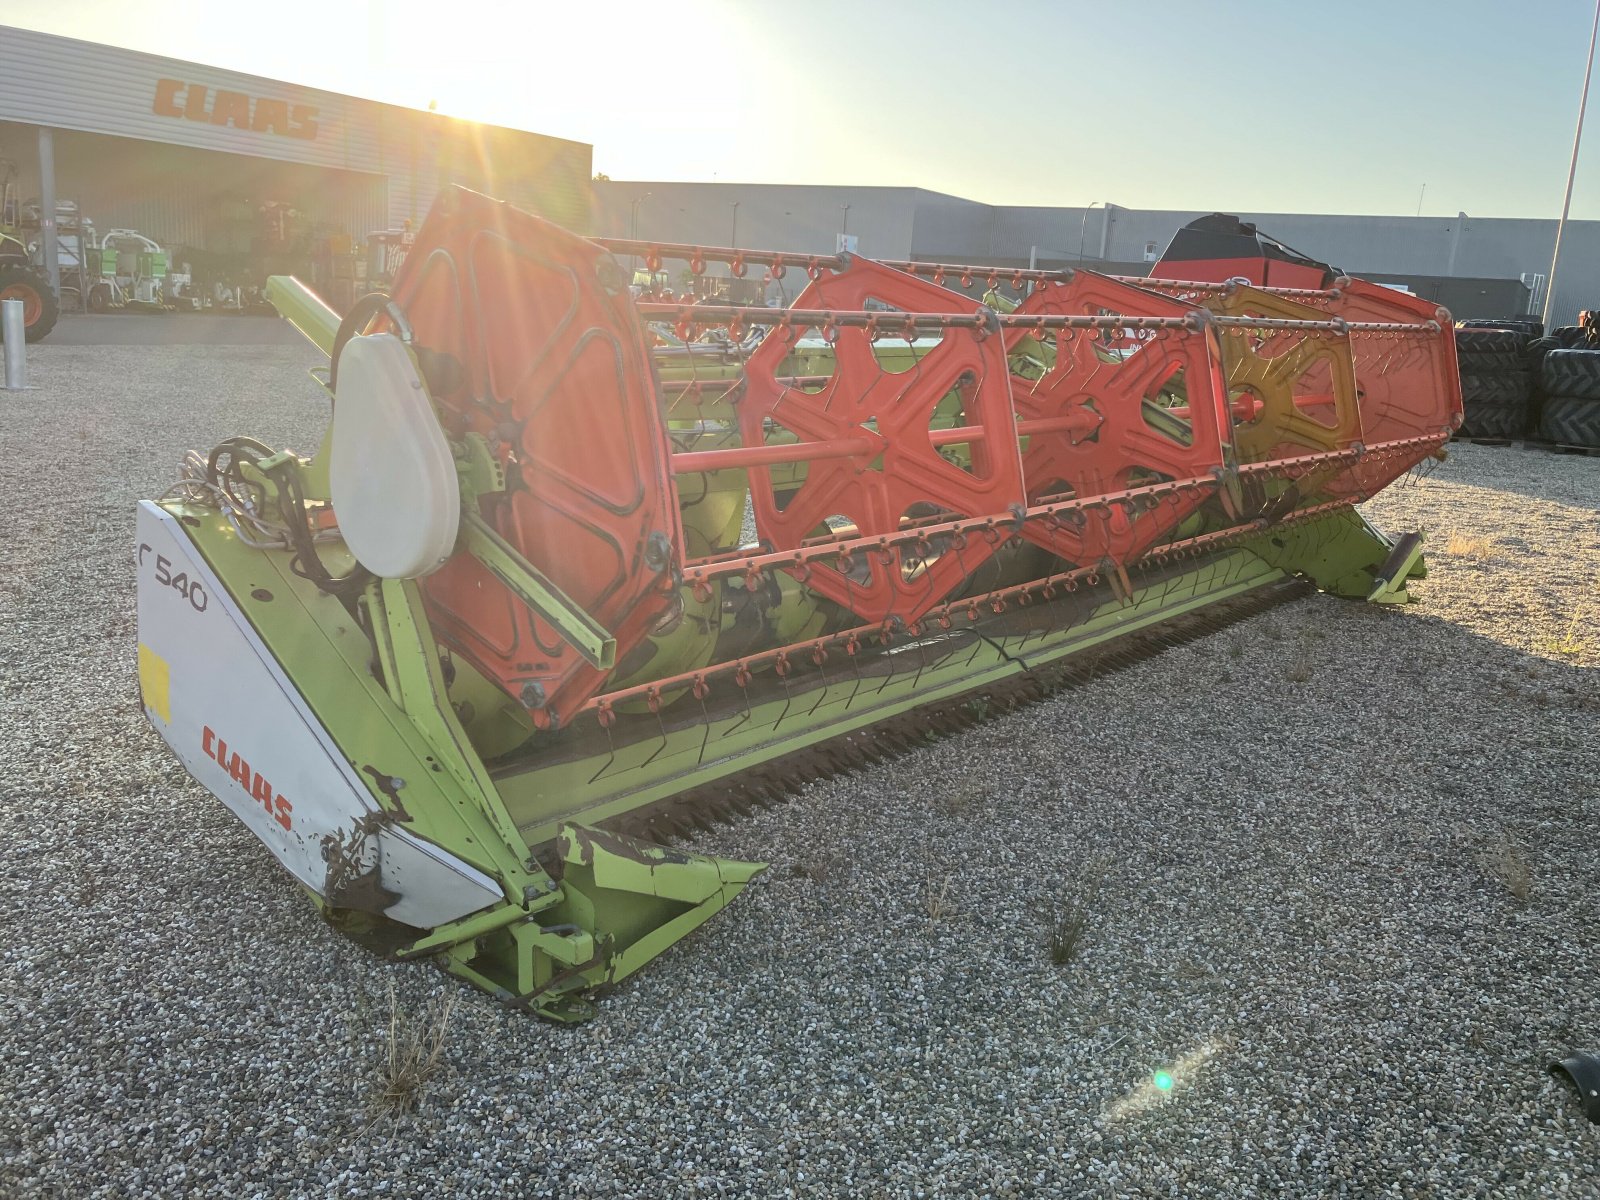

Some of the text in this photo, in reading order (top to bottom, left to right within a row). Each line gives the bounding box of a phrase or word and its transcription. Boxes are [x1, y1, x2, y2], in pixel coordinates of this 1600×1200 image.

[152, 78, 320, 141] CLAAS
[155, 554, 208, 613] 540
[202, 725, 293, 831] CLAAS
